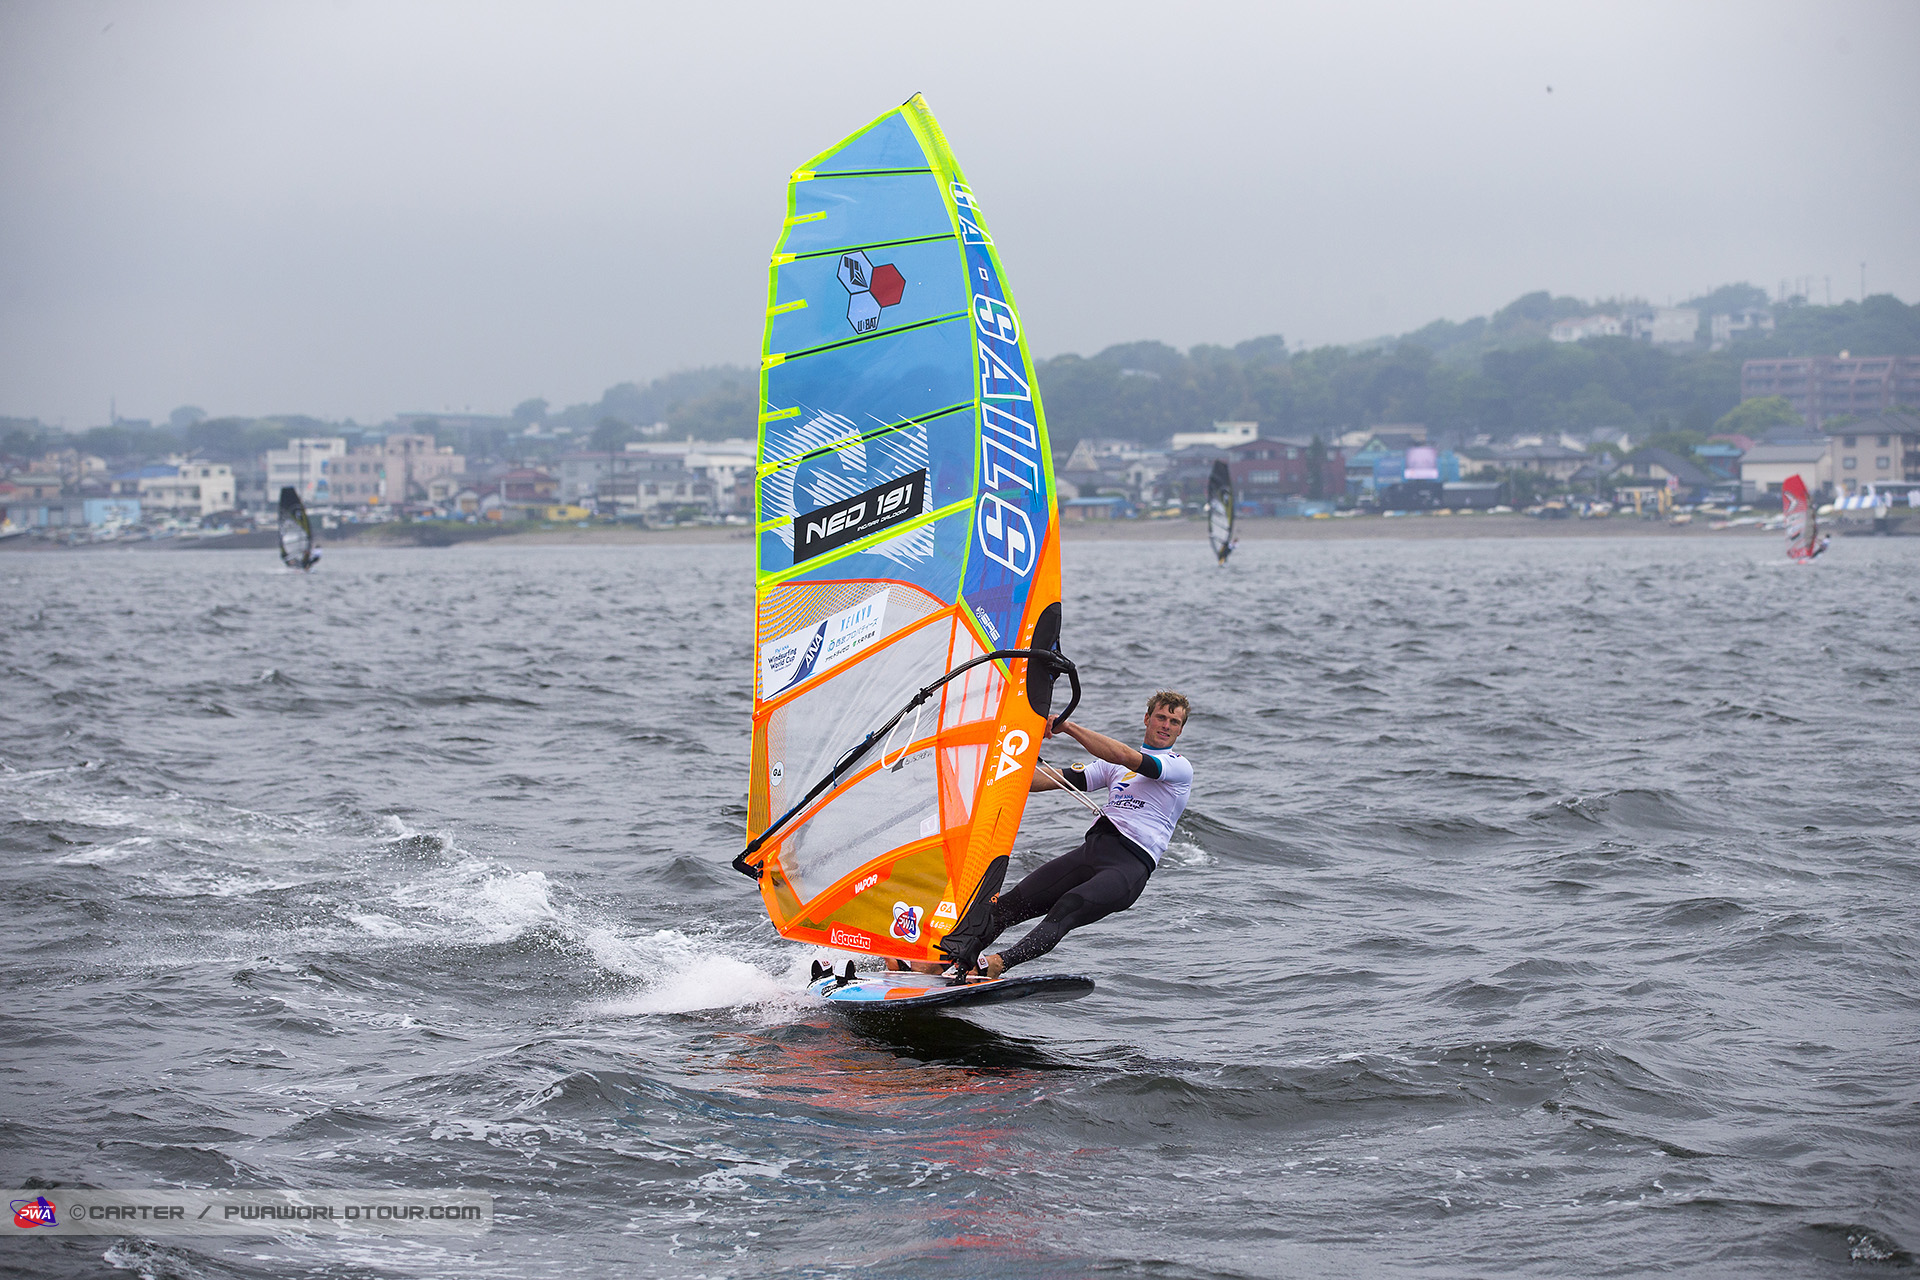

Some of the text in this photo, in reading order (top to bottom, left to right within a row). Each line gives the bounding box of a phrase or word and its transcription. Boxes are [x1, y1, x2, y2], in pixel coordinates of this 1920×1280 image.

[973, 293, 1039, 577] SAILS
[805, 483, 913, 545] NED 191
[804, 633, 823, 669] ANA
[994, 729, 1030, 782] GA
[854, 873, 878, 894] VAPOR
[940, 903, 952, 914] GA
[835, 929, 871, 950] Gaastra
